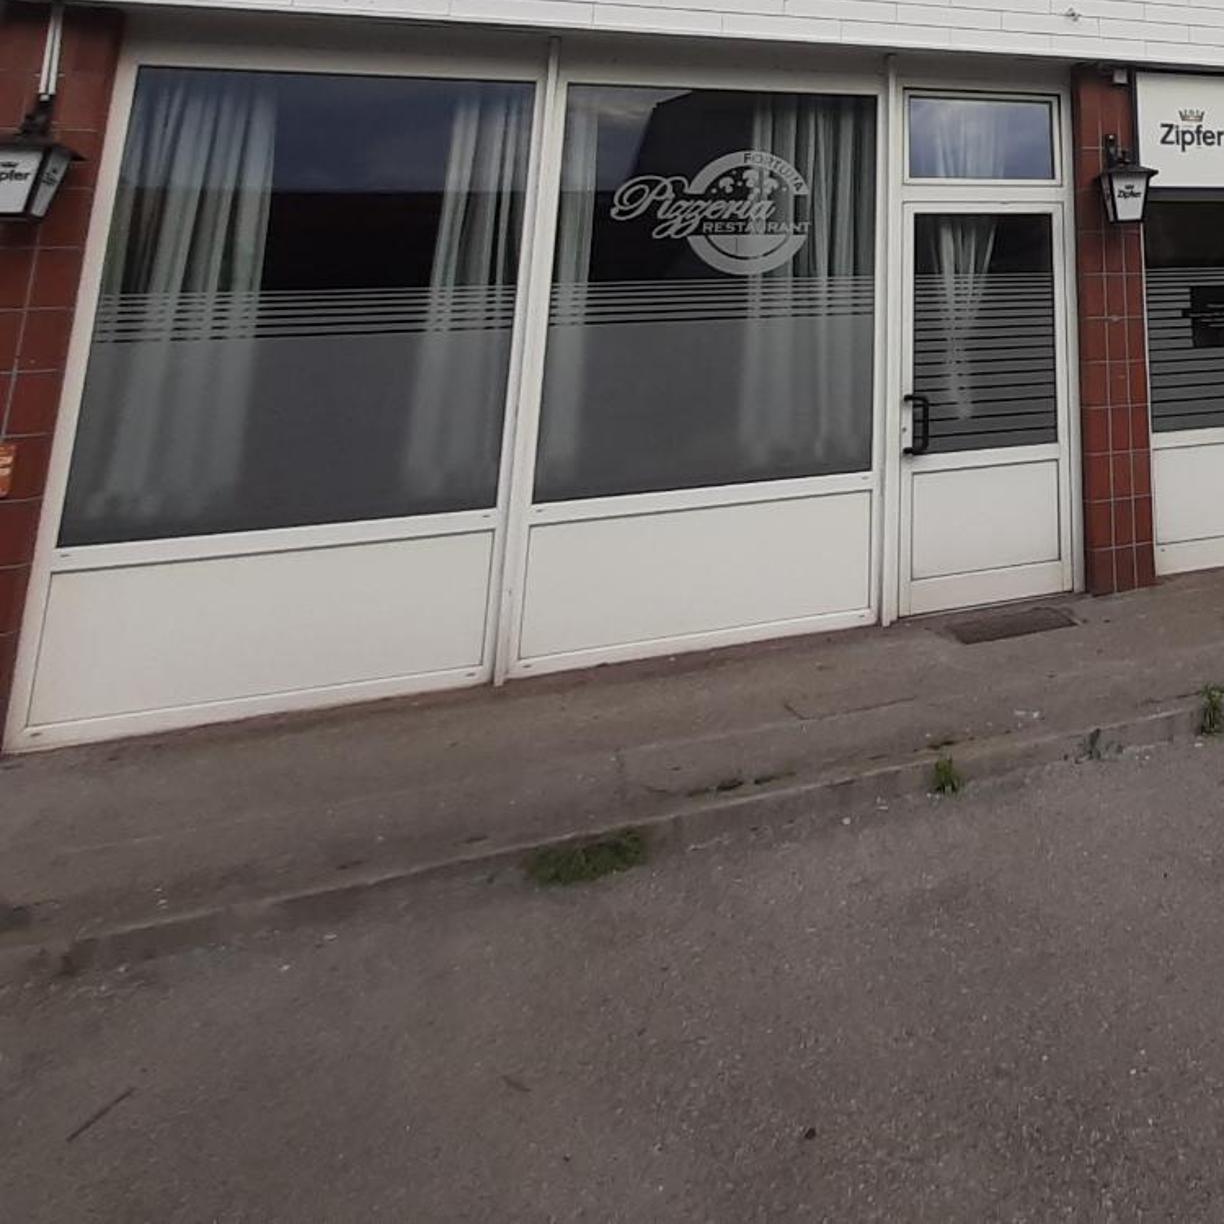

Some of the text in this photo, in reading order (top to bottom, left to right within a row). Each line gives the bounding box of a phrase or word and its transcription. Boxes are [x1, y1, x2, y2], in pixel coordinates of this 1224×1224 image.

[1160, 123, 1224, 152] Zipfer
[610, 175, 776, 239] Pizzeria
[702, 220, 811, 233] RESTAURANT
